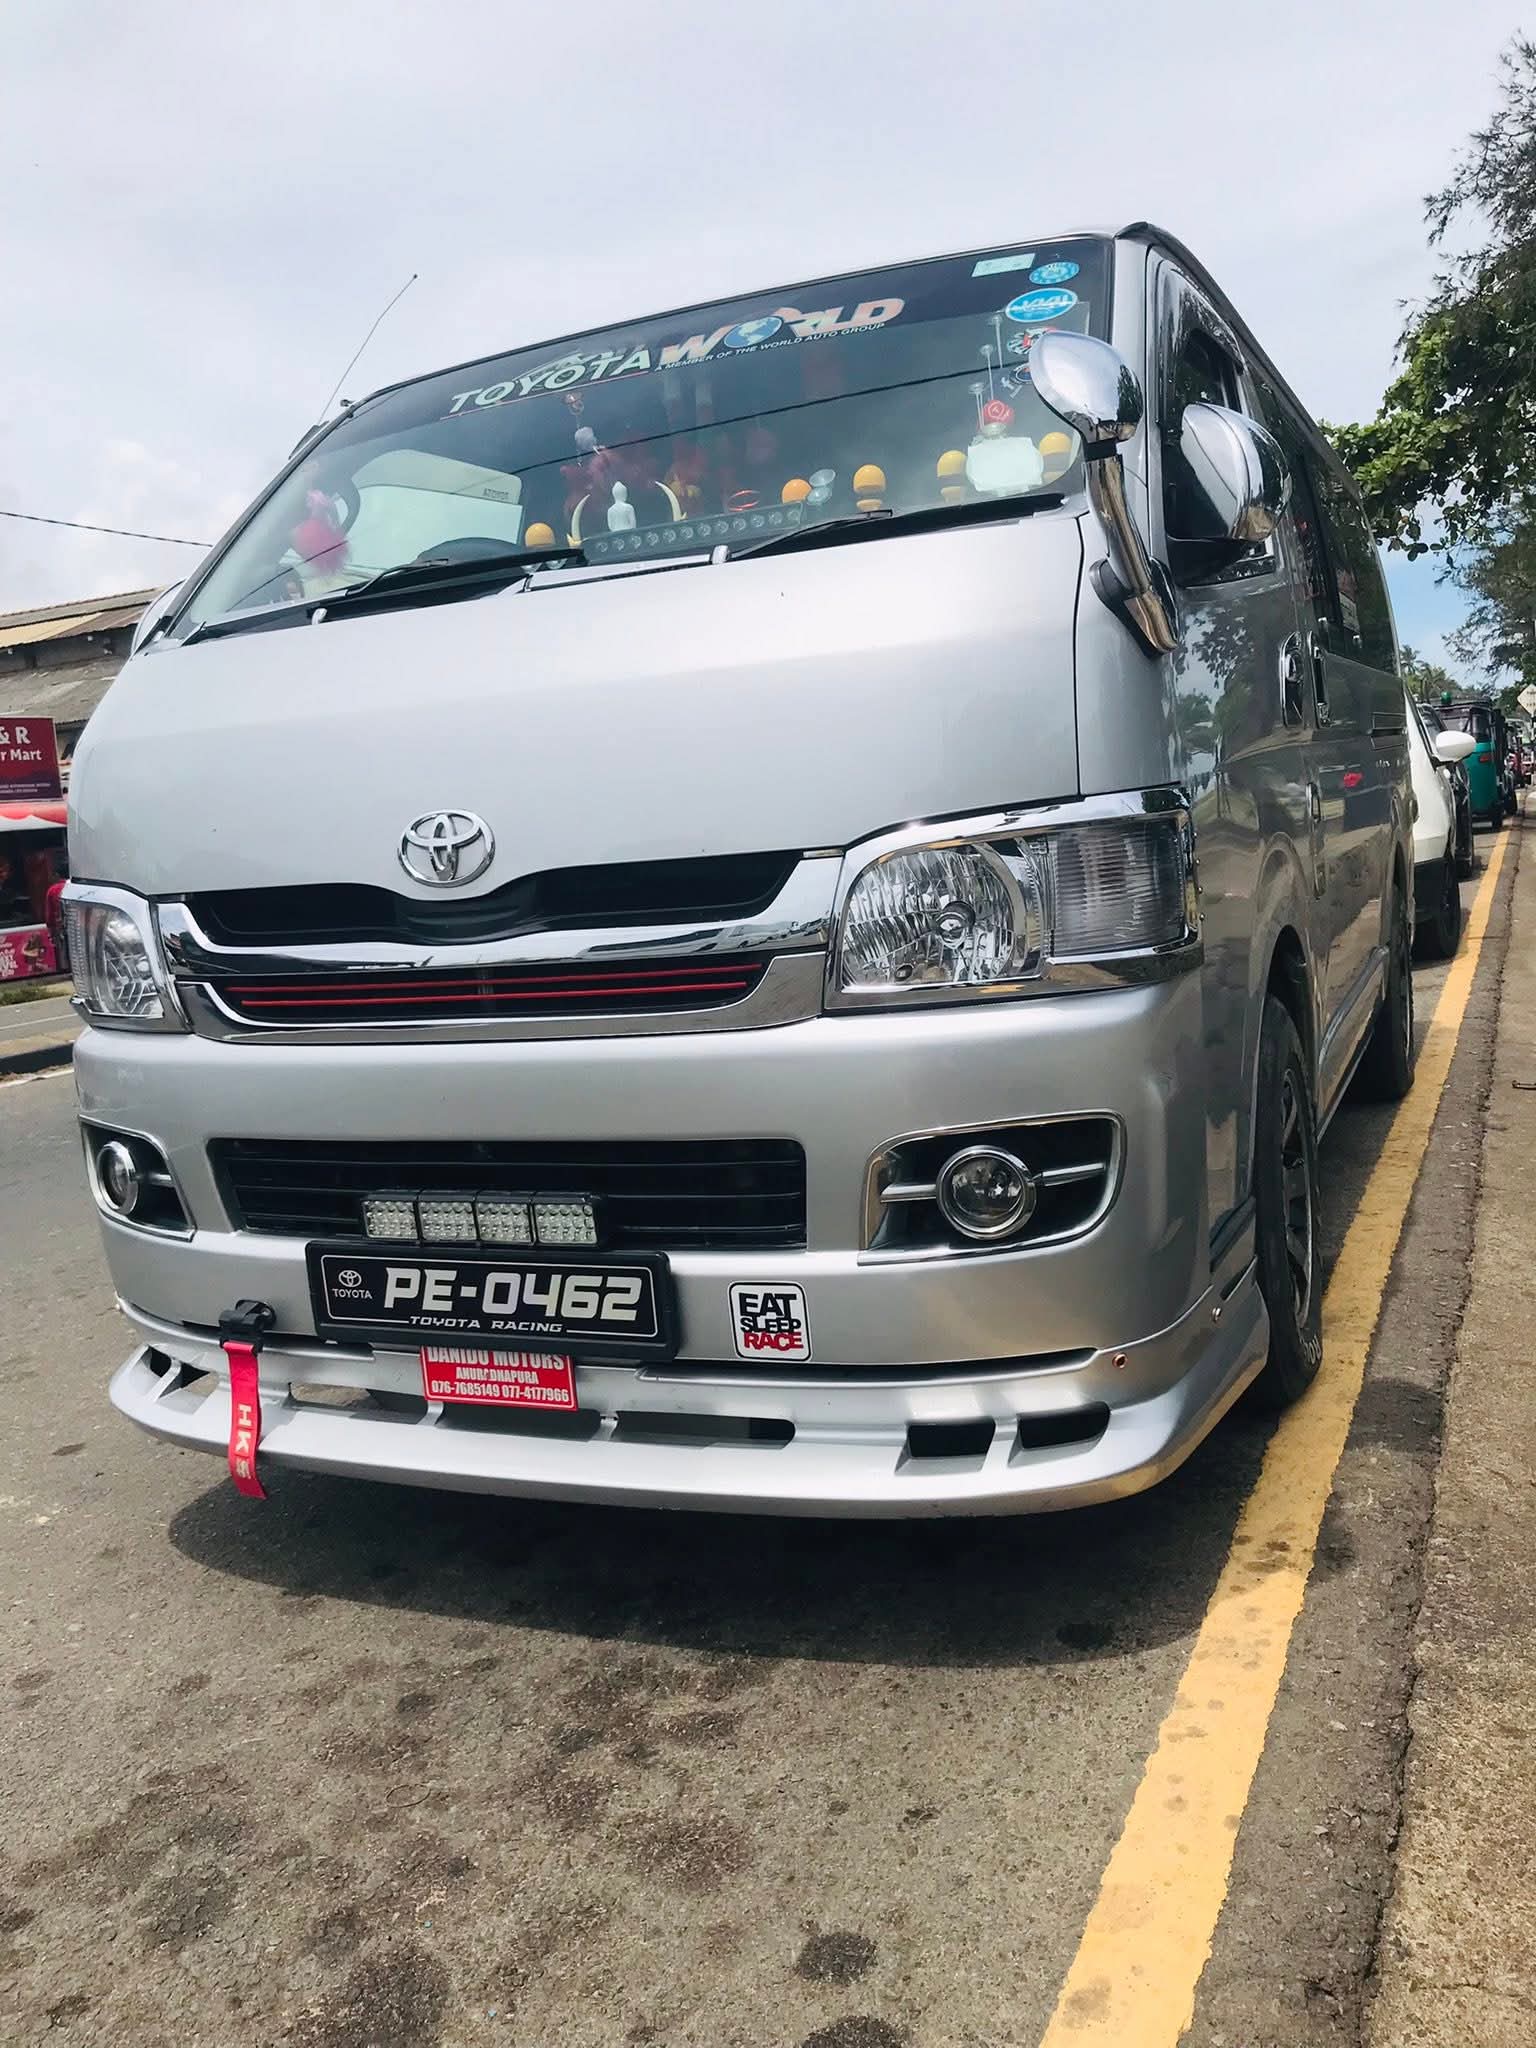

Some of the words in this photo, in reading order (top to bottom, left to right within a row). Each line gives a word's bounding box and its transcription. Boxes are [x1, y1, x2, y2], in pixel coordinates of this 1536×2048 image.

[450, 349, 650, 413] TOYOTA
[658, 298, 905, 365] WORLD
[665, 356, 713, 369] MEMBER
[716, 350, 734, 360] OF
[735, 345, 757, 355] THE
[760, 337, 803, 350] WORLD
[804, 330, 837, 342] AUTO
[840, 322, 886, 335] GROUP
[15, 727, 31, 744] R
[10, 749, 42, 760] Mart
[332, 1288, 373, 1300] TOYOTA
[384, 1267, 642, 1321] PE-0462
[739, 1293, 797, 1317] EAT
[409, 1316, 481, 1329] TOYOTA
[491, 1321, 563, 1333] RACING
[740, 1316, 802, 1333] SLEEP
[744, 1331, 804, 1351] RACE
[431, 1380, 500, 1397] 076-7685149
[502, 1385, 569, 1402] 077-4177966
[235, 1404, 252, 1478] HKS
